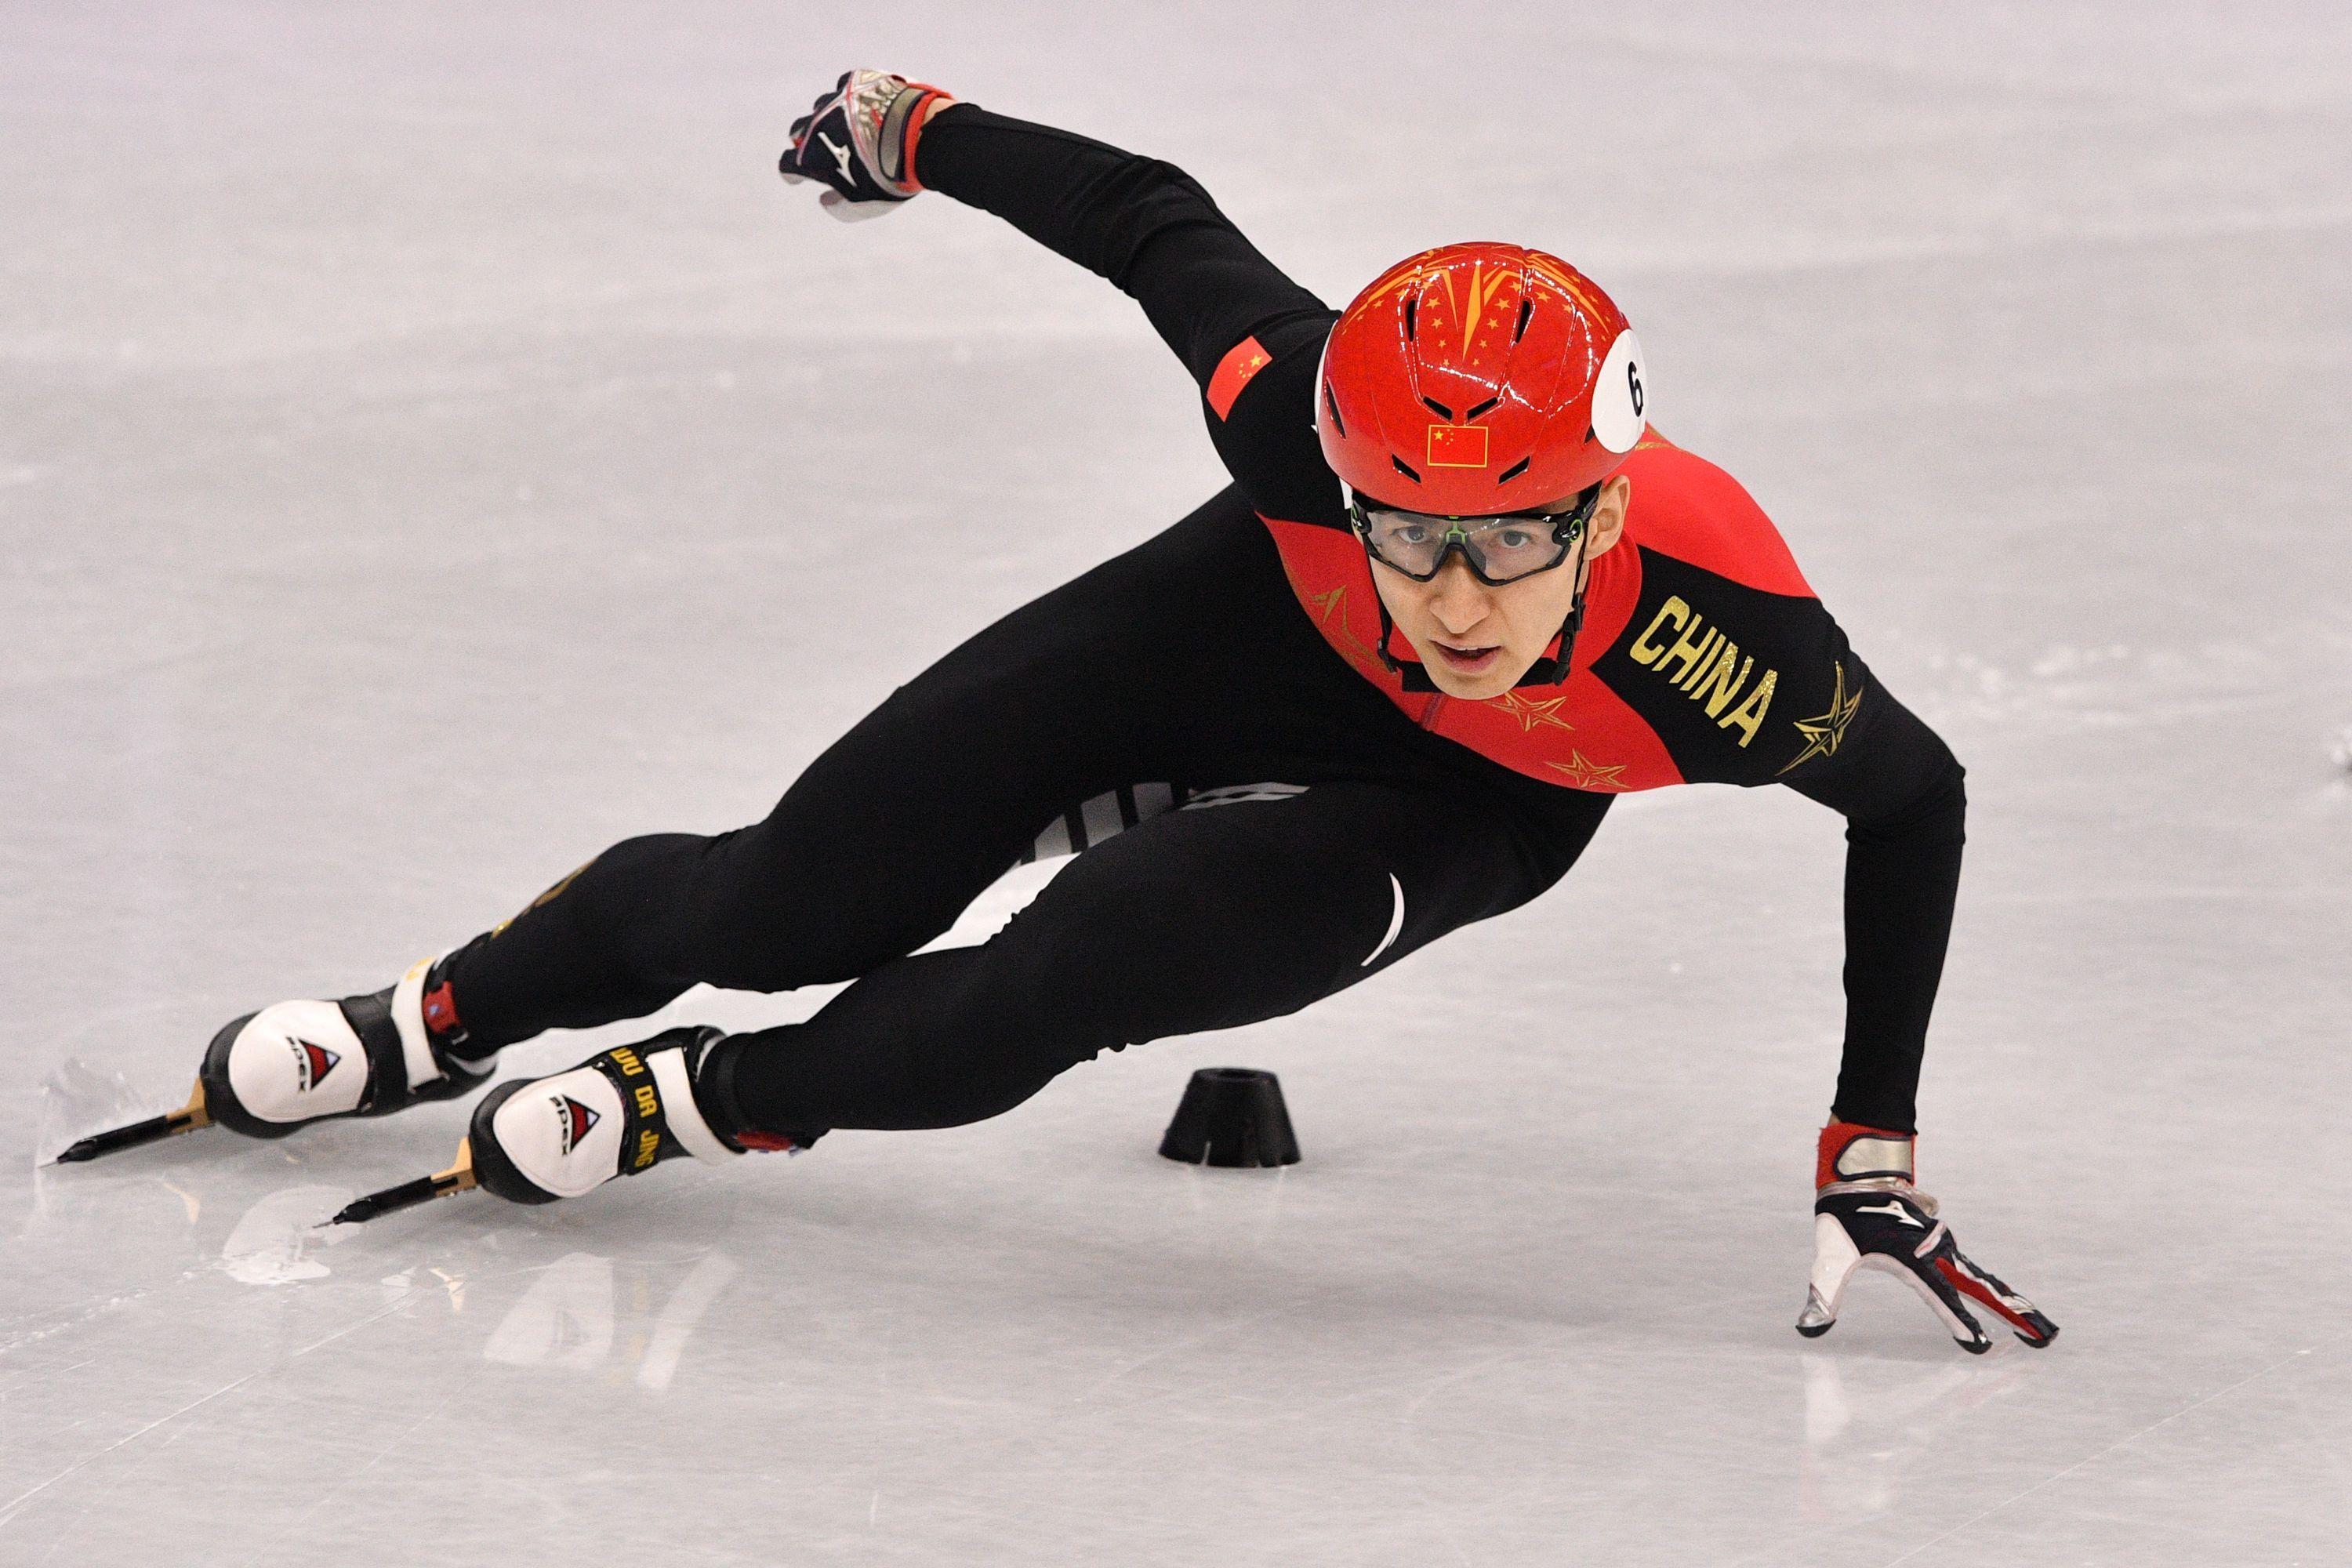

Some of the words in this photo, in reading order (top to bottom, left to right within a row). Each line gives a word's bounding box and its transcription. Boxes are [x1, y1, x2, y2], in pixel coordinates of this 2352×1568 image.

[1628, 361, 1644, 418] 6
[1629, 595, 1778, 748] CHINA
[609, 1047, 644, 1076] WU
[634, 1084, 658, 1118] DA
[633, 1129, 660, 1168] JING
